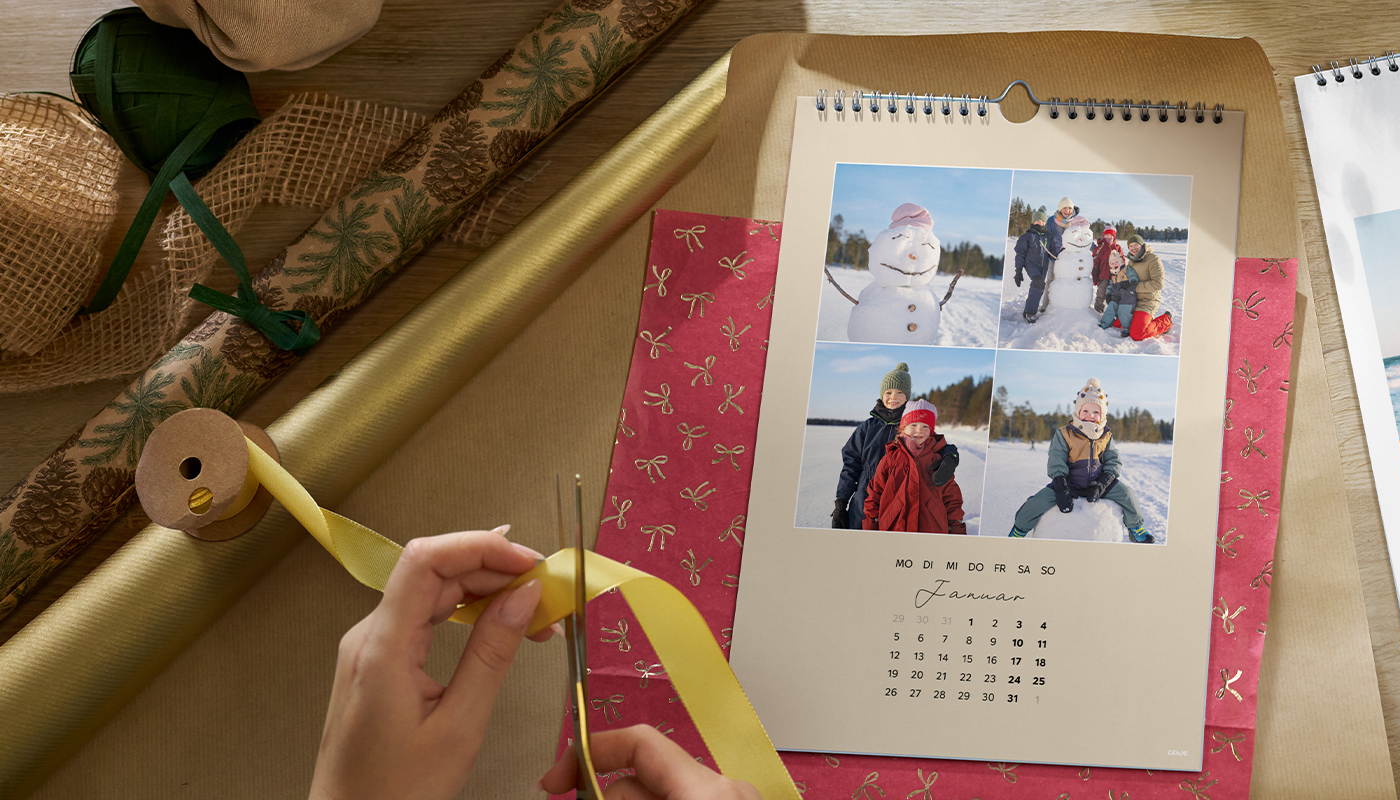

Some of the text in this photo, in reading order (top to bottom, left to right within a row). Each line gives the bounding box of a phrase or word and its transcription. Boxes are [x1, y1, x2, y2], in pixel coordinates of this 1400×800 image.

[895, 559, 1055, 575] MO DI MI DO FR SA SO
[915, 579, 1025, 608] Januar
[892, 614, 904, 623] 29
[917, 615, 929, 624] 30
[941, 617, 952, 625] 31
[969, 618, 973, 626] 1
[992, 619, 998, 627] 2
[1016, 621, 1022, 629] 3
[894, 633, 1047, 648] 5 6 7 8 9 10 11
[890, 651, 1046, 667] 12 13 14 15 16 17 18
[888, 670, 1045, 685] 19 20 21 22 23 24 25
[885, 688, 897, 696] 26
[909, 689, 921, 697] 27
[934, 690, 945, 699] 28
[958, 692, 970, 700] 29
[982, 693, 994, 701] 30
[1007, 694, 1018, 702] 31
